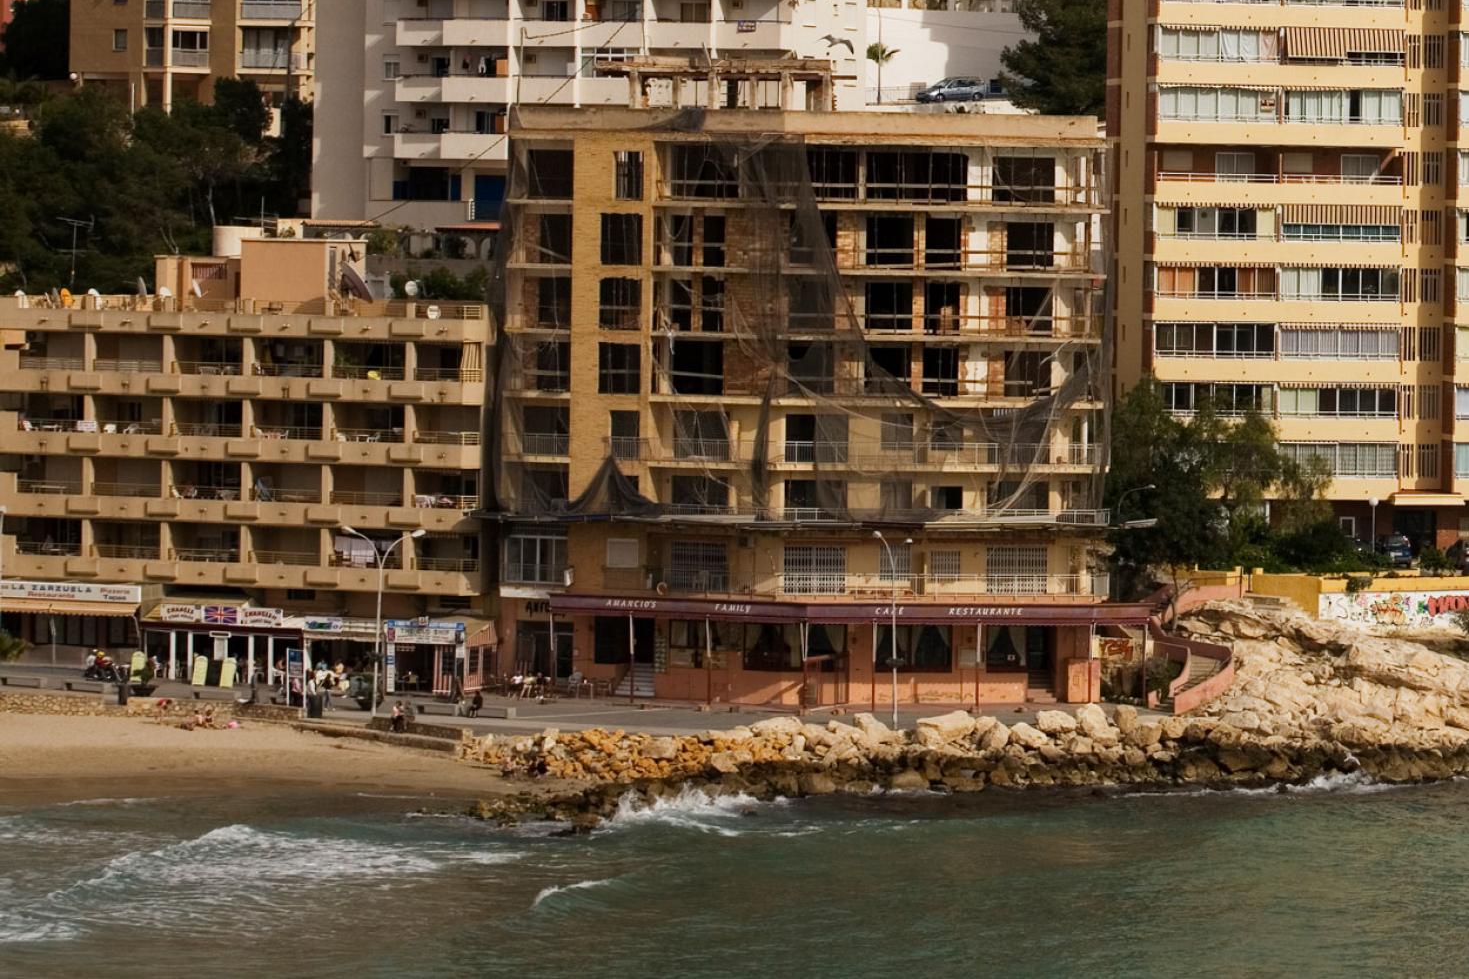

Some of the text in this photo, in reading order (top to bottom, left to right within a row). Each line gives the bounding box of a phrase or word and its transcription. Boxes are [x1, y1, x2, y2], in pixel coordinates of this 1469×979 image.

[31, 584, 92, 593] ZARZUELA
[606, 599, 751, 613] AMANCIO'S FAMILY
[949, 607, 1024, 616] RESTAURANTE
